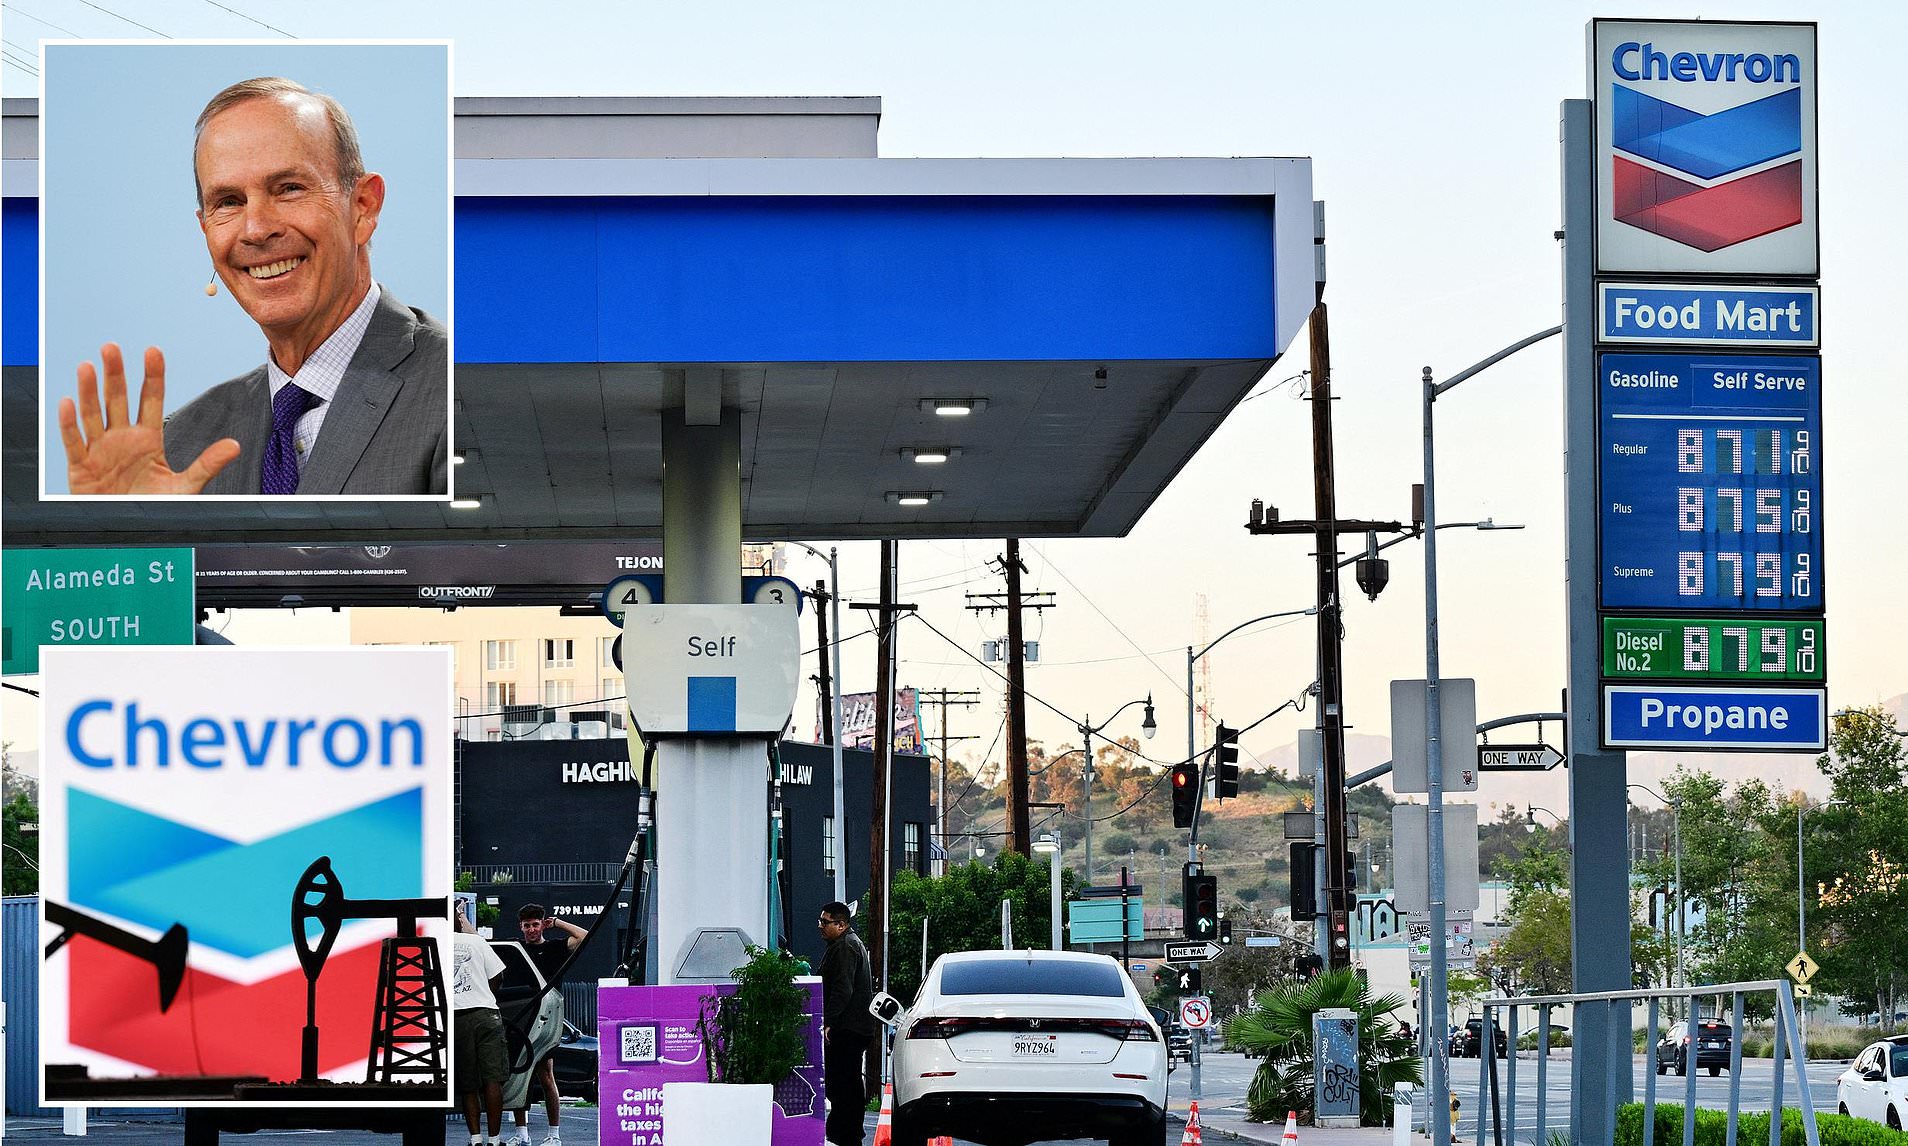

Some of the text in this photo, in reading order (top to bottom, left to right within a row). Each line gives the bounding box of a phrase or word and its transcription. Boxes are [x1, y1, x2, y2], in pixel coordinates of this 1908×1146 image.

[1611, 41, 1801, 84] Chevron
[1614, 297, 1801, 332] Food Mart
[1609, 370, 1806, 391] Gasoline Self Serve
[1613, 443, 1648, 457] Regular
[1677, 429, 1781, 474] 871
[1613, 503, 1633, 514] Plus
[1678, 487, 1781, 533] 875
[615, 556, 664, 569] TEJON
[25, 560, 175, 592] Alameda St
[1613, 566, 1654, 579] Supreme
[1678, 551, 1782, 597] 879
[621, 588, 639, 605] 4
[768, 588, 784, 604] 3
[50, 615, 141, 642] SOUTH
[687, 636, 737, 658] Self
[1616, 631, 1663, 651] Diesel
[1683, 626, 1787, 672] 879
[1616, 652, 1652, 672] No.2
[1641, 698, 1789, 736] Propane
[64, 699, 425, 771] Chevron
[1483, 752, 1544, 765] ONE WAY
[562, 761, 636, 783] HAGHI
[552, 906, 572, 915] 739
[572, 906, 582, 914] N.
[1172, 947, 1206, 957] ONE WAY
[1014, 1042, 1055, 1054] 9RYZ964
[622, 1088, 664, 1101] Califo
[617, 1104, 642, 1117] the
[620, 1120, 662, 1131] taxes
[632, 1133, 647, 1146] in
